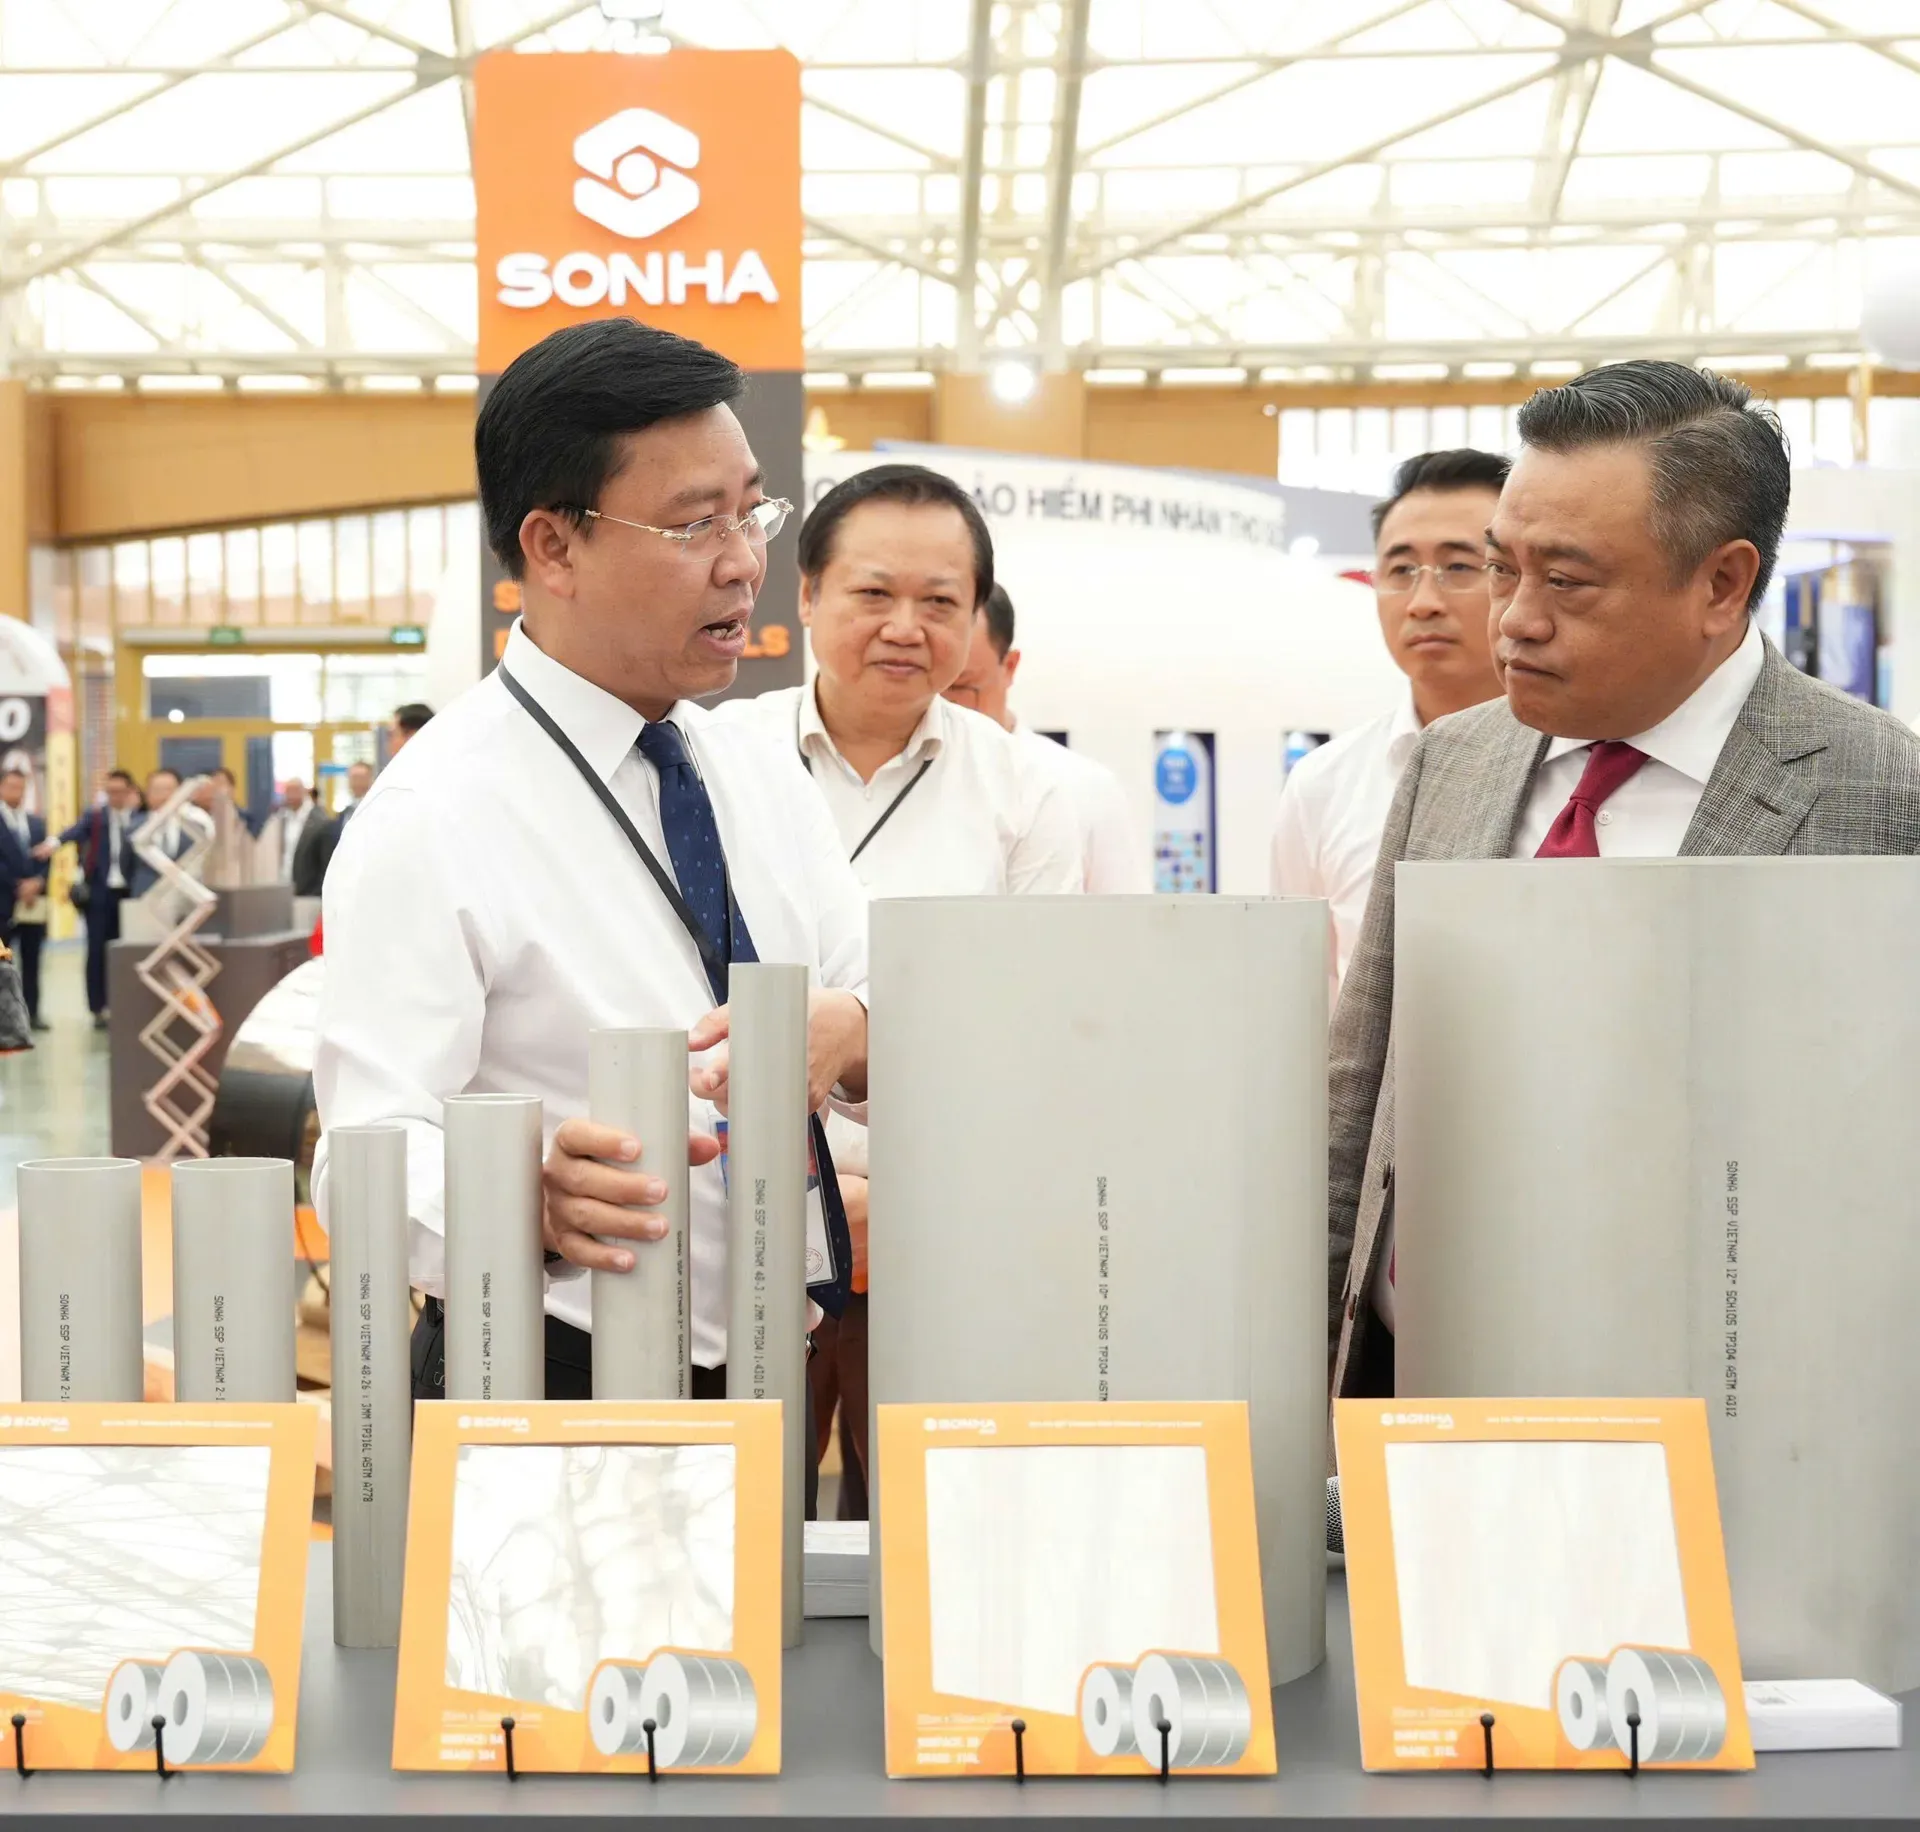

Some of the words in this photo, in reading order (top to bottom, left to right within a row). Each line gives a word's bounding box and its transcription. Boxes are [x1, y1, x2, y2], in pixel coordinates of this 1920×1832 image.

[496, 249, 780, 308] SONHA
[1726, 1160, 1739, 1192] SONHA
[754, 1178, 766, 1206] SONHA
[1096, 1176, 1108, 1208] SONHA
[1726, 1196, 1739, 1217] SSP
[754, 1209, 766, 1227] SSP
[1097, 1212, 1109, 1232] SSP
[754, 1230, 766, 1268] VIETNAM
[1098, 1235, 1110, 1279] VIETNAM
[1726, 1221, 1739, 1264] VIETNAM
[676, 1259, 684, 1276] SSP
[360, 1272, 371, 1301] SONHA
[481, 1271, 492, 1299] SONHA
[676, 1279, 684, 1317] VIETNAM
[59, 1293, 70, 1321] SONHA
[213, 1294, 225, 1323] SONHA
[360, 1304, 371, 1321] SSP
[481, 1302, 492, 1319] SSP
[1726, 1290, 1738, 1326] SCH10S
[59, 1324, 71, 1342] SSP
[213, 1326, 225, 1344] SSP
[360, 1323, 372, 1362] VIETNAM
[481, 1321, 492, 1358] VIETNAM
[1726, 1330, 1738, 1361] TP304
[60, 1344, 71, 1382] VIETNAM
[214, 1346, 226, 1384] VIETNAM
[1097, 1345, 1109, 1375] TP304
[1725, 1365, 1738, 1390] ASTM
[60, 1385, 71, 1400] 2-1
[1725, 1395, 1738, 1418] A312
[361, 1402, 372, 1420] 3MM
[361, 1423, 373, 1453] TP316L
[361, 1456, 373, 1479] ASTM
